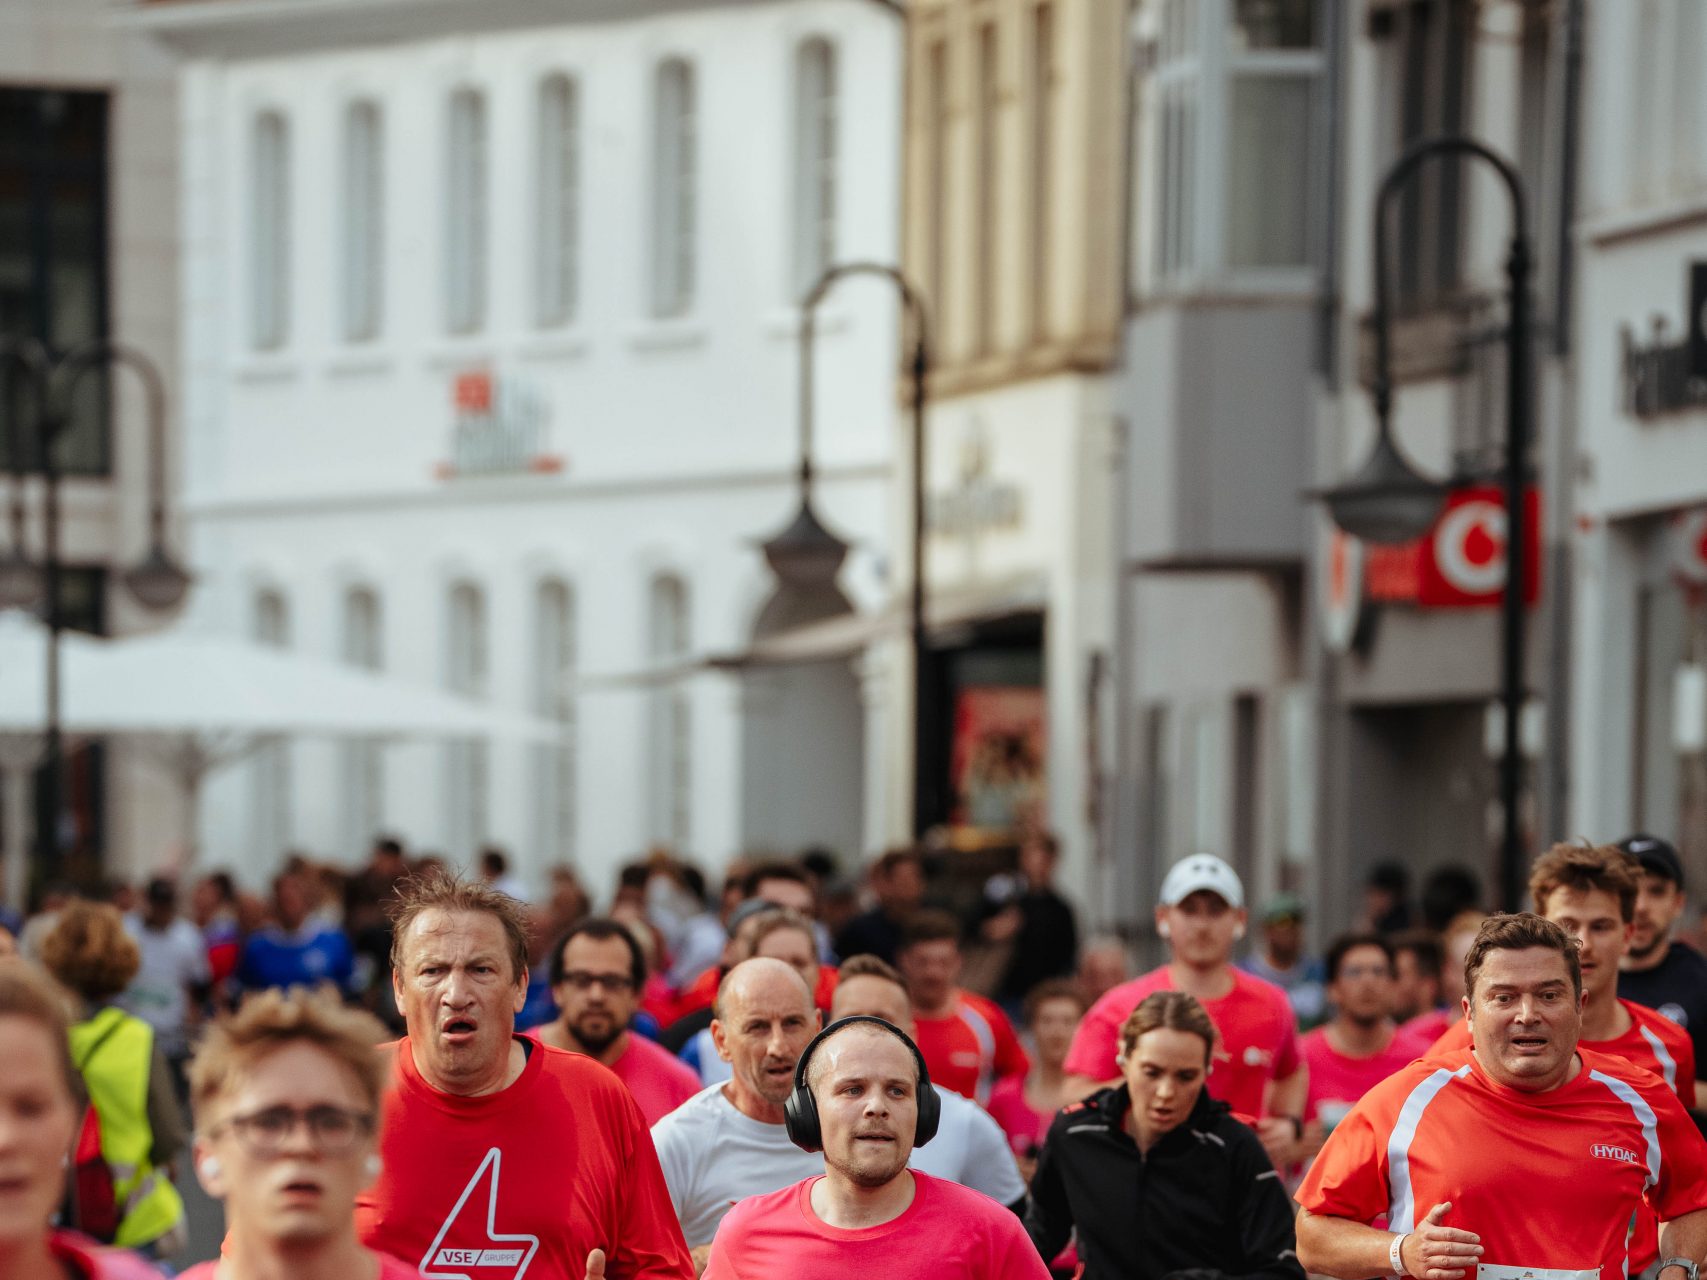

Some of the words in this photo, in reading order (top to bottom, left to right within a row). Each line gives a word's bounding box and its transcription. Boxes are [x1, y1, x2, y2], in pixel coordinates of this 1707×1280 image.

[1594, 1145, 1637, 1165] HYDAC
[443, 1251, 473, 1263] VSE
[484, 1253, 516, 1262] GRUPPE
